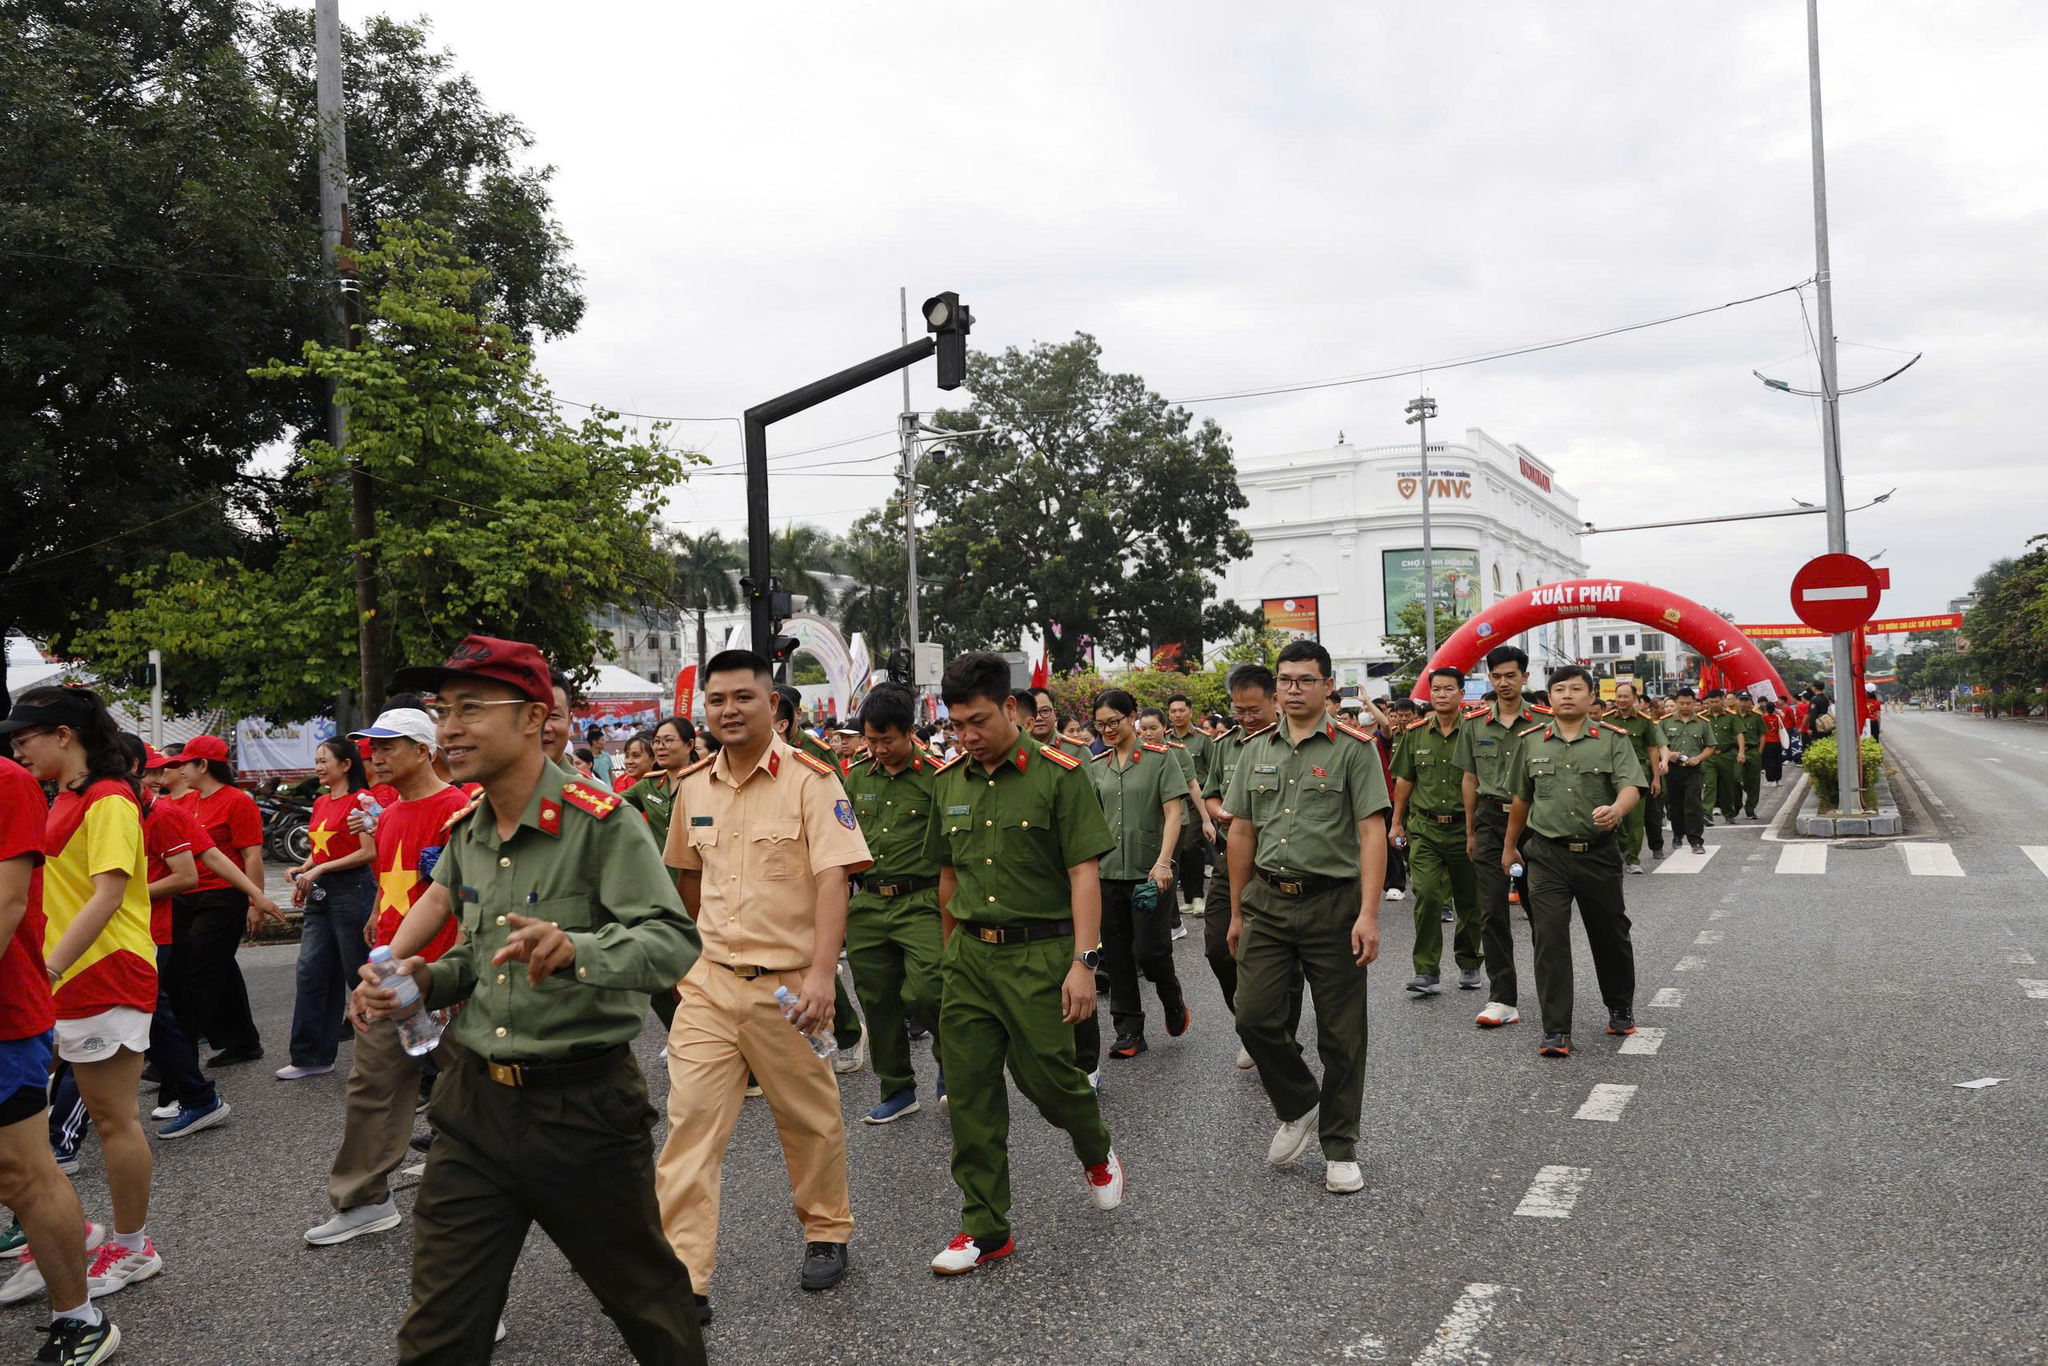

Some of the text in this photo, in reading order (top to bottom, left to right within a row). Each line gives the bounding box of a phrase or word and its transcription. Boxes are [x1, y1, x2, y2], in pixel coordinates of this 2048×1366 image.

[1420, 478, 1472, 499] VNVC
[1530, 582, 1623, 606] XUẤT PHÁT
[1580, 604, 1597, 613] Dân
